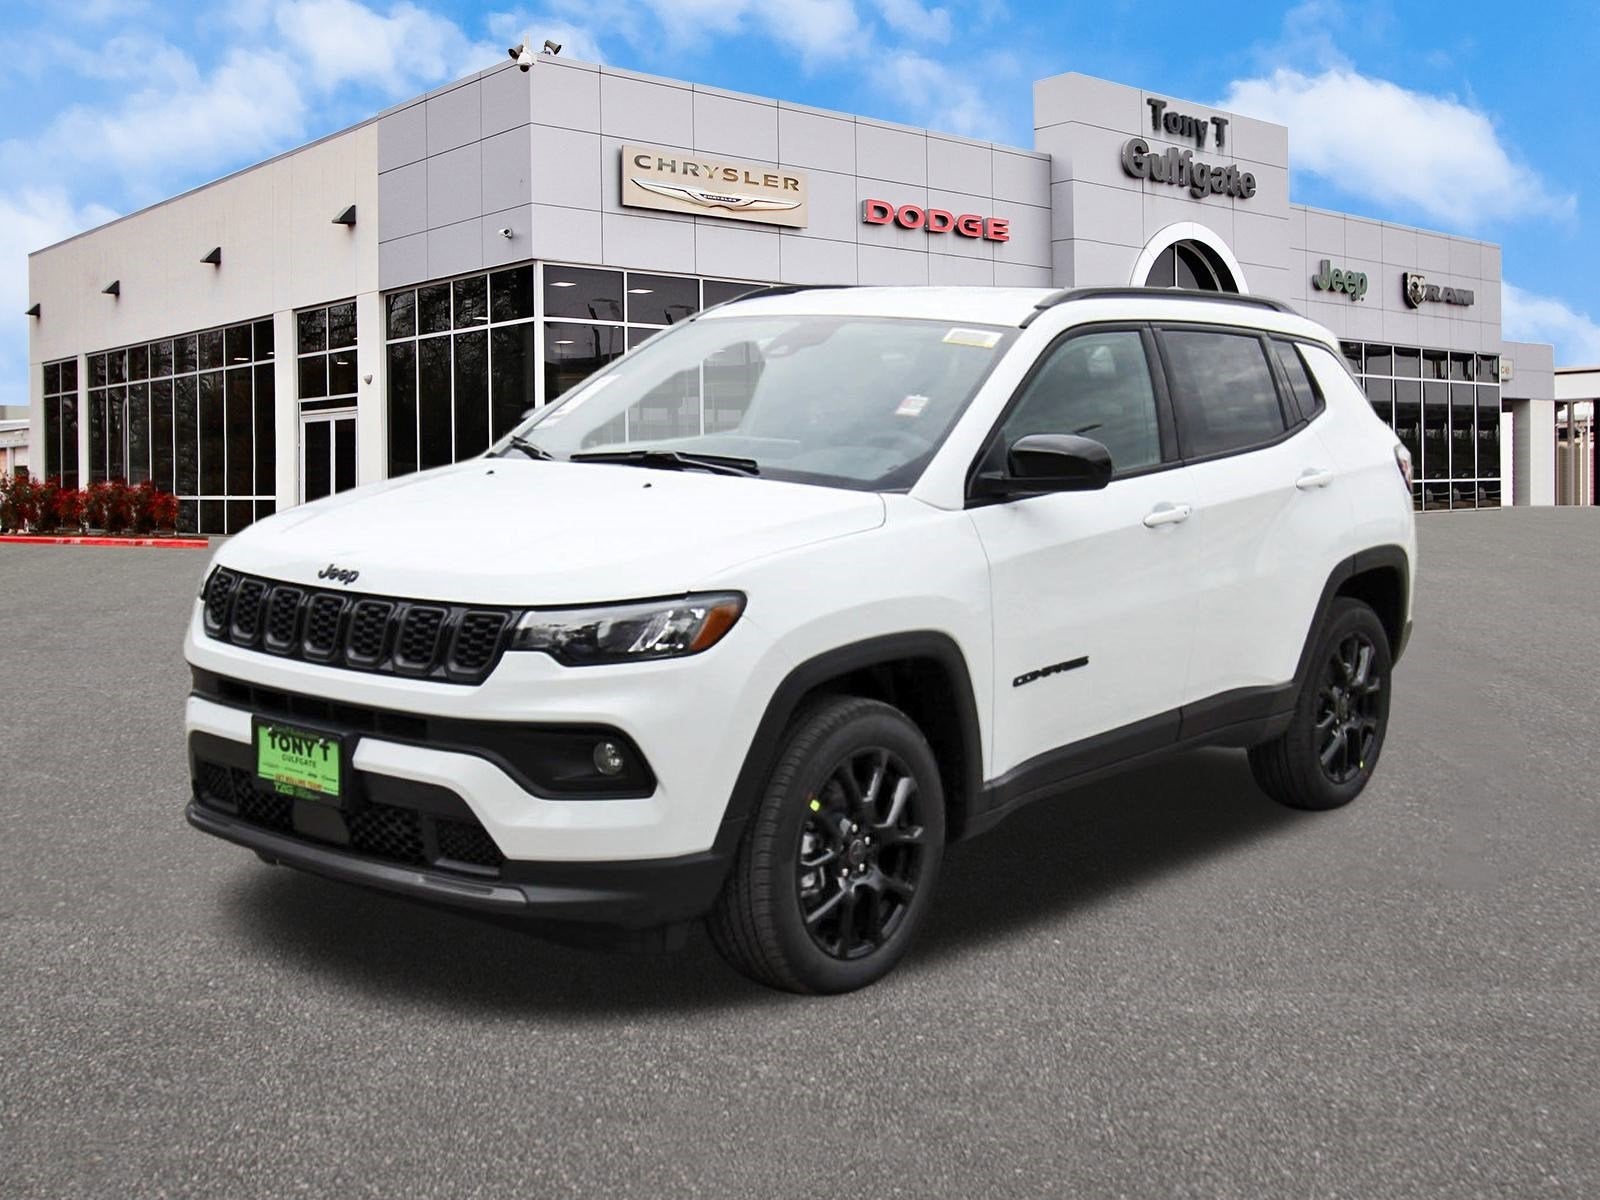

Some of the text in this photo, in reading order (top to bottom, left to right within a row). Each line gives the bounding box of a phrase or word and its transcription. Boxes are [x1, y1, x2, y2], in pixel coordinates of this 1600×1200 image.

[1147, 98, 1229, 147] Tony T
[634, 153, 801, 192] CHRYSLER
[1121, 138, 1257, 199] Gulfgate
[863, 198, 1011, 242] DODGE
[1312, 259, 1368, 301] Jeep
[1425, 284, 1474, 306] RAM
[318, 563, 360, 585] Jeep
[268, 730, 316, 758] TONY
[319, 741, 331, 762] T
